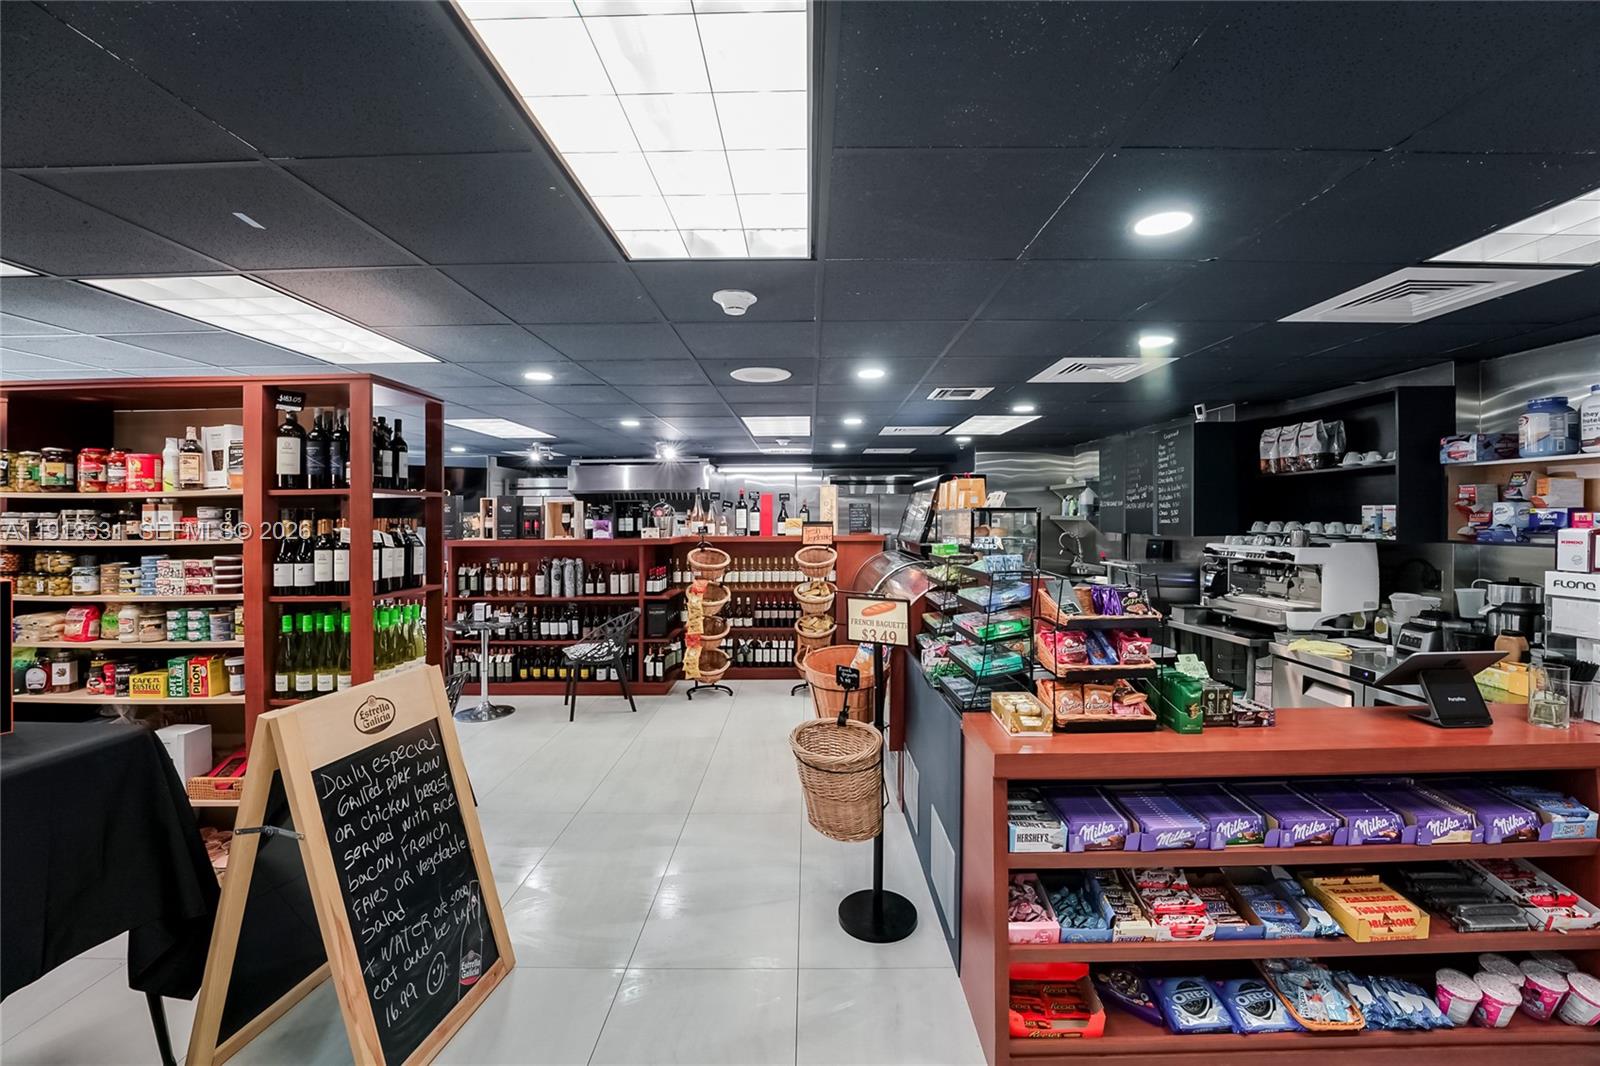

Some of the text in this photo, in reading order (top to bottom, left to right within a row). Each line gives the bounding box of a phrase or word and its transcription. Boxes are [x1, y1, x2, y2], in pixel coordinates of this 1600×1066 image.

[1553, 579, 1597, 592] FLONQ
[850, 617, 875, 628] FRENCH
[861, 629, 897, 645] $349
[192, 665, 201, 695] PILON
[359, 703, 390, 720] Estrella
[363, 712, 391, 729] Galicia
[321, 730, 440, 800] Daily especial
[402, 806, 429, 832] with
[1216, 818, 1251, 838] Milka
[1355, 815, 1390, 837] Milka
[1426, 816, 1461, 837] Milka
[1493, 815, 1527, 835] Milka
[1016, 833, 1049, 843] HERSHEY'S
[1078, 821, 1116, 842] Milka
[1156, 829, 1192, 847] Milka
[1292, 820, 1327, 841] Milka
[416, 834, 467, 876] vegetable
[1330, 887, 1384, 895] TOBLERONE
[1341, 895, 1399, 904] TOBLERONE
[1353, 905, 1413, 915] TOBLERONE
[381, 914, 432, 962] WATER
[373, 966, 399, 999] eat
[404, 938, 433, 971] and
[434, 923, 451, 941] be
[461, 959, 481, 971] Estrella
[461, 967, 481, 979] Galicia
[385, 982, 419, 1028] 16.99
[1172, 990, 1211, 1005] OREO
[1235, 991, 1274, 1007] OREO
